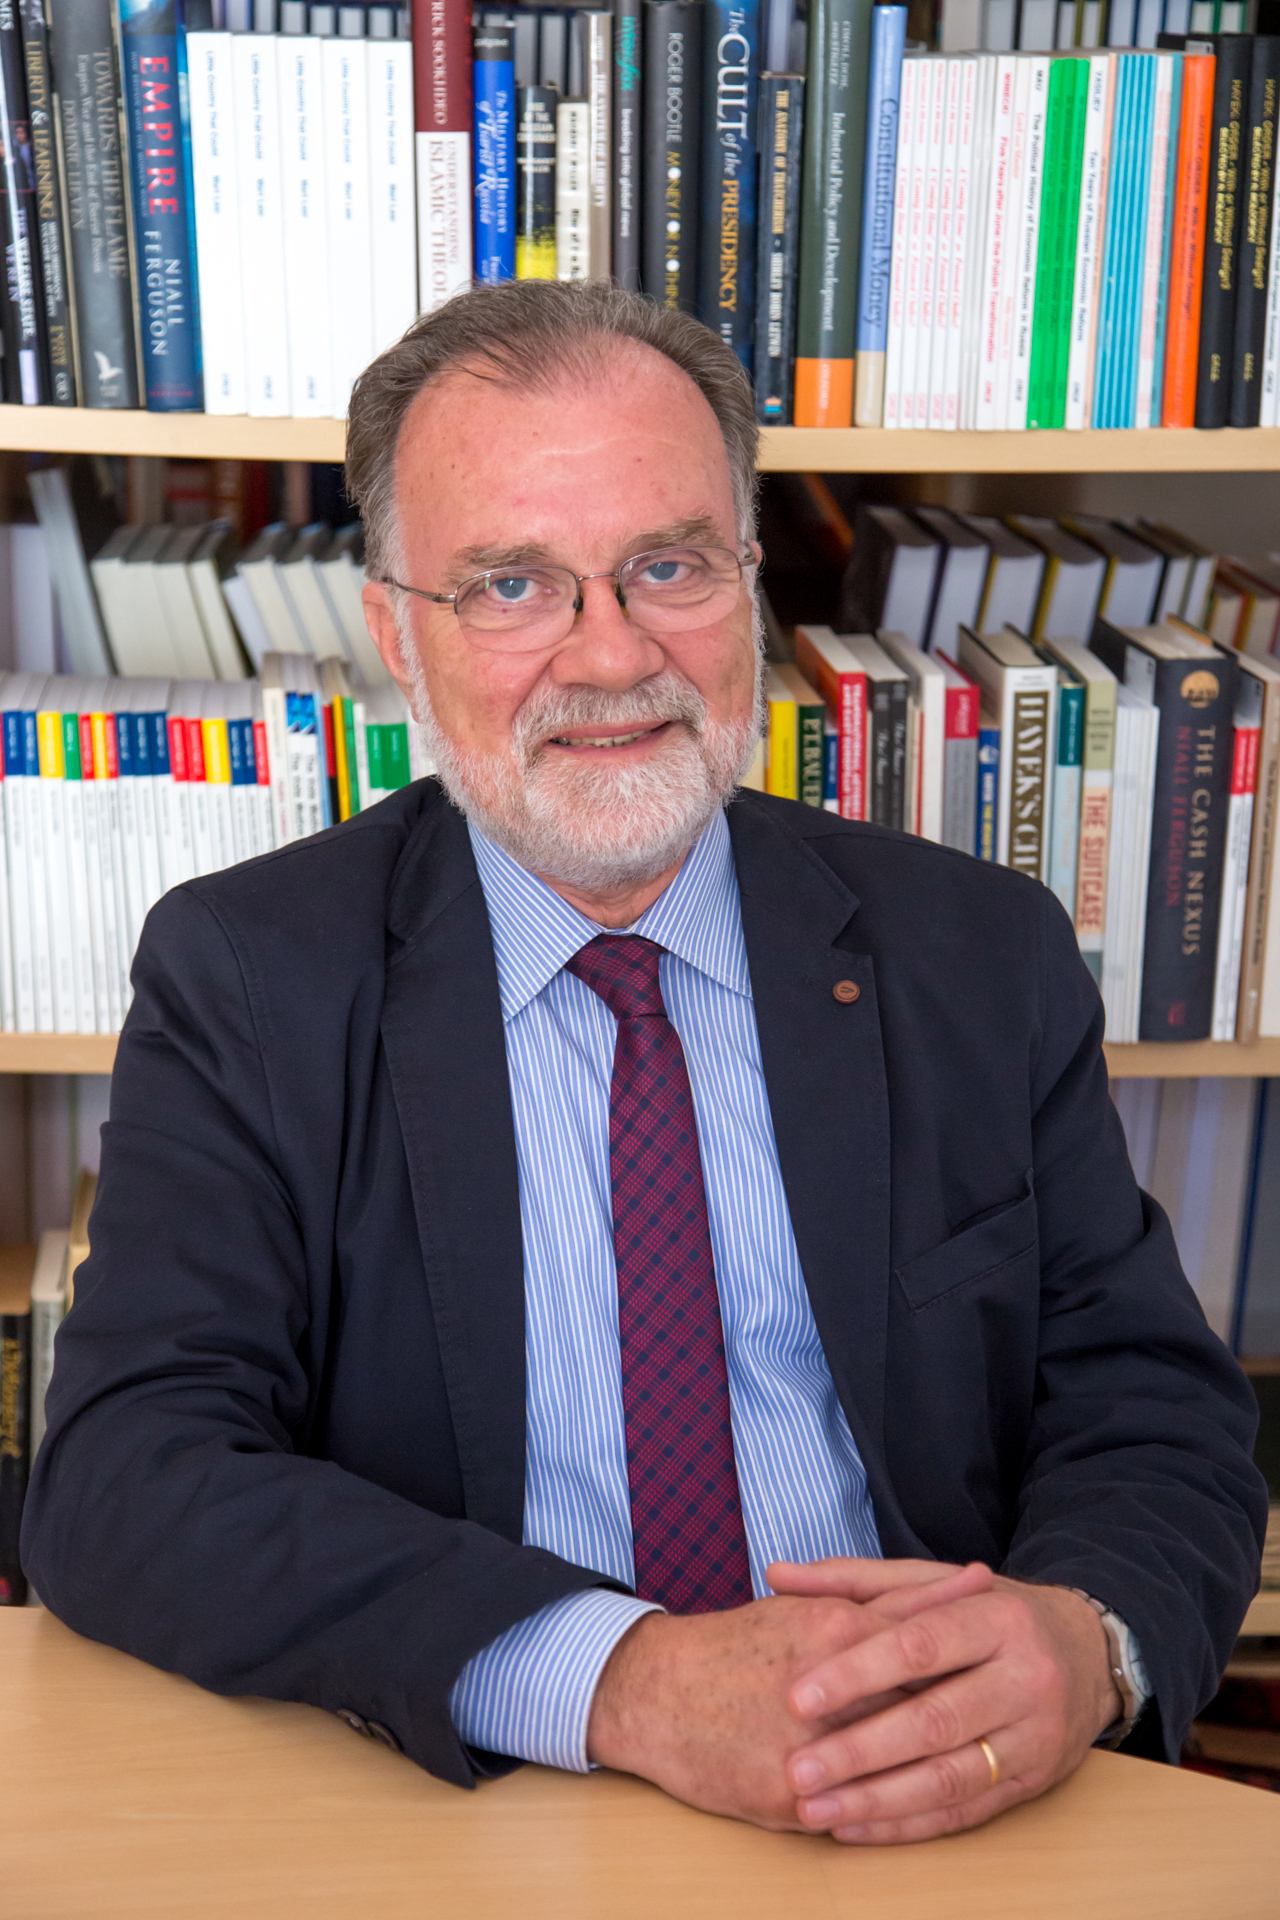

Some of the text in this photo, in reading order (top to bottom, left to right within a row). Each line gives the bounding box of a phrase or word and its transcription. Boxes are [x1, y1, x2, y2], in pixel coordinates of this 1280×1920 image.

[729, 8, 746, 34] The
[26, 41, 47, 109] LIBERTY
[432, 40, 448, 125] SOOKHDEO
[666, 33, 684, 143] ROGER BOOTLE
[717, 33, 751, 141] CULT
[775, 90, 789, 109] THE
[31, 109, 50, 126] &
[62, 99, 82, 169] DOMINIC
[139, 56, 179, 216] EMPIRE
[719, 133, 743, 152] of
[774, 110, 788, 154] ANATOMY
[1228, 121, 1240, 161] ORDER
[1261, 120, 1273, 160] ORDER
[33, 129, 58, 219] LEARNING
[93, 48, 128, 280] TOWARDS THE FLAME
[430, 141, 446, 222] ISLAMIC
[619, 108, 634, 238] breaking into global news
[665, 151, 681, 242] MONEY FOR
[724, 152, 742, 177] the
[773, 156, 786, 169] OF
[1226, 168, 1238, 192] With
[1259, 167, 1271, 192] With
[447, 141, 460, 264] UNDERSTANDING
[496, 178, 510, 234] HISTORY
[772, 171, 786, 235] THATCHERISM
[819, 112, 846, 331] Industrial Policy and Development
[865, 97, 900, 330] Constitutional Money
[1222, 206, 1236, 247] Without
[1255, 205, 1269, 246] Without
[719, 180, 740, 312] PRESIDENCY
[770, 252, 784, 290] SHIRLEY
[143, 230, 170, 356] FERGUSON
[163, 259, 186, 328] NIALL
[1014, 696, 1045, 820] HAYEK'S
[1194, 725, 1216, 779] THE
[1165, 725, 1193, 907] NIALL FERGUSON
[1189, 788, 1211, 860] CASH
[1081, 796, 1107, 929] THE SUITCASE
[1181, 871, 1205, 956] NEXUS
